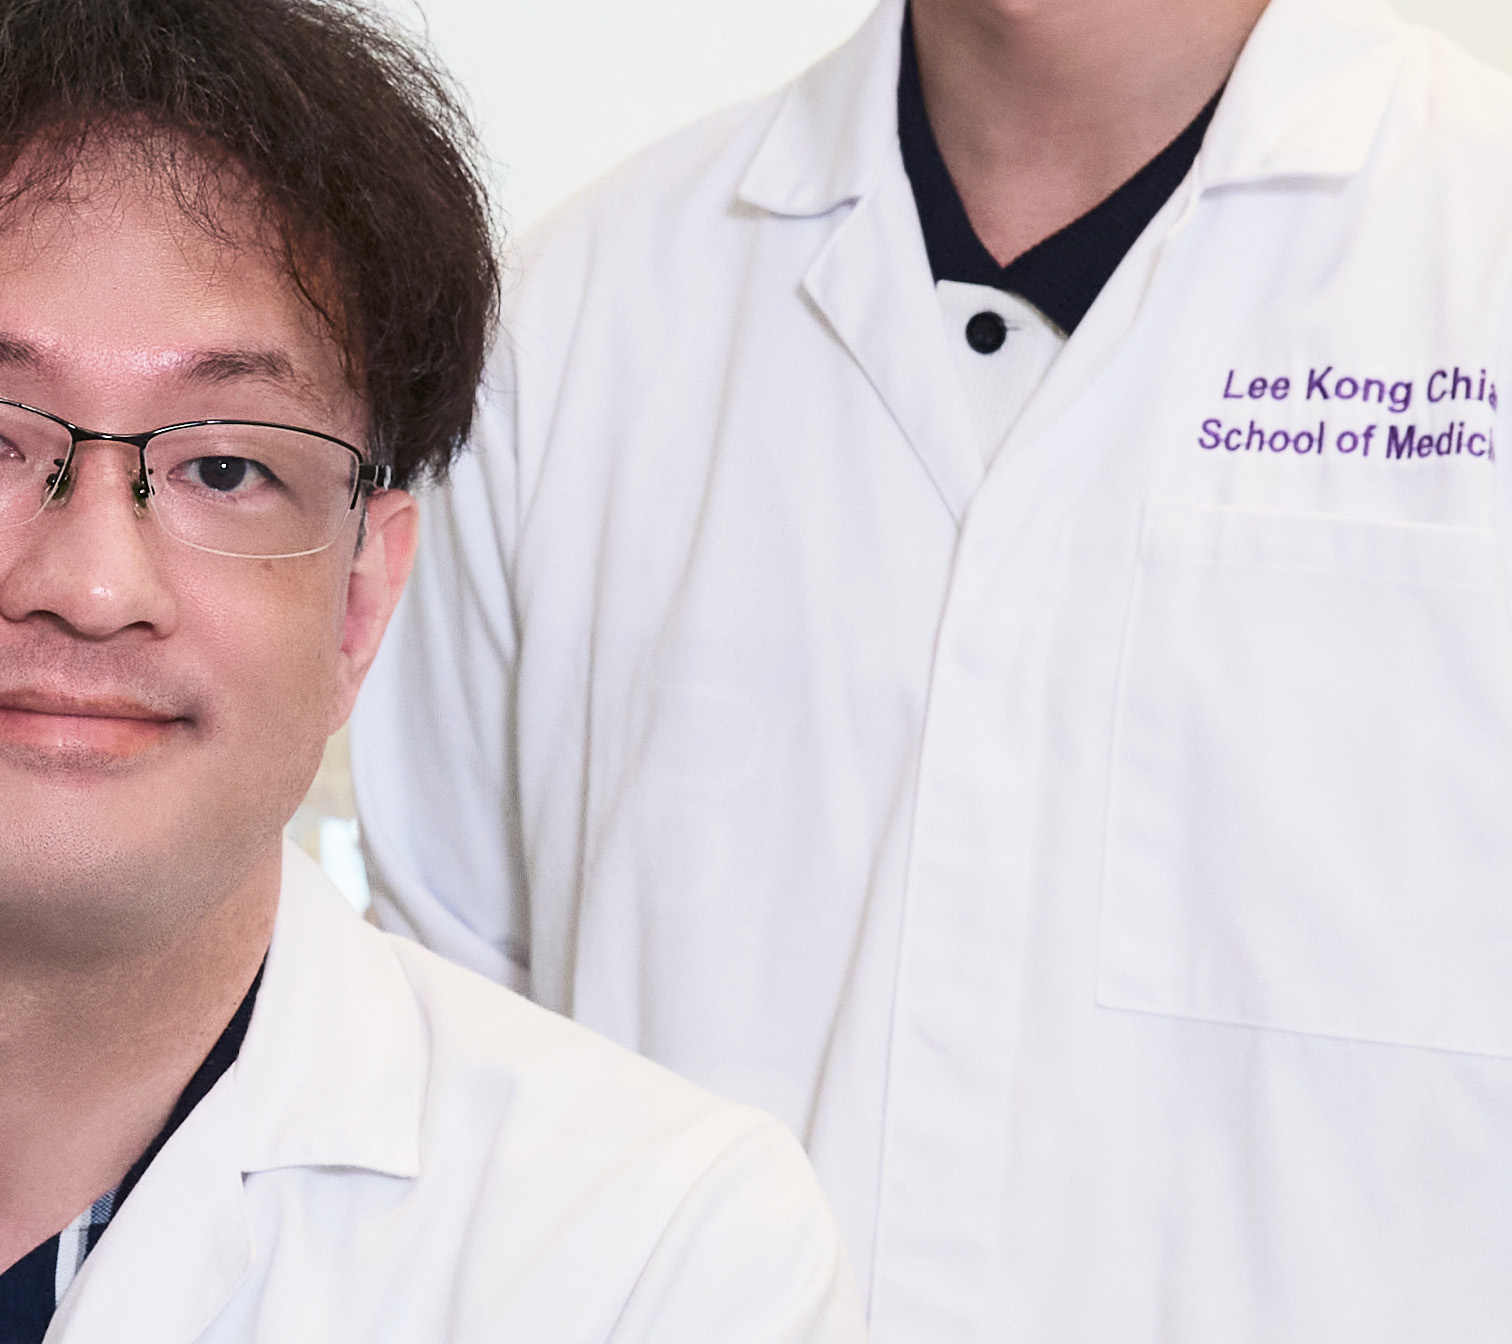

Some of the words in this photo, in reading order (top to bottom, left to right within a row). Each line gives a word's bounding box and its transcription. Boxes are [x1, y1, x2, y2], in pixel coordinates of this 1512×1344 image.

[1223, 369, 1290, 400] Lee
[1306, 366, 1413, 413] Kong
[1198, 418, 1325, 455] School
[1336, 424, 1377, 457] of
